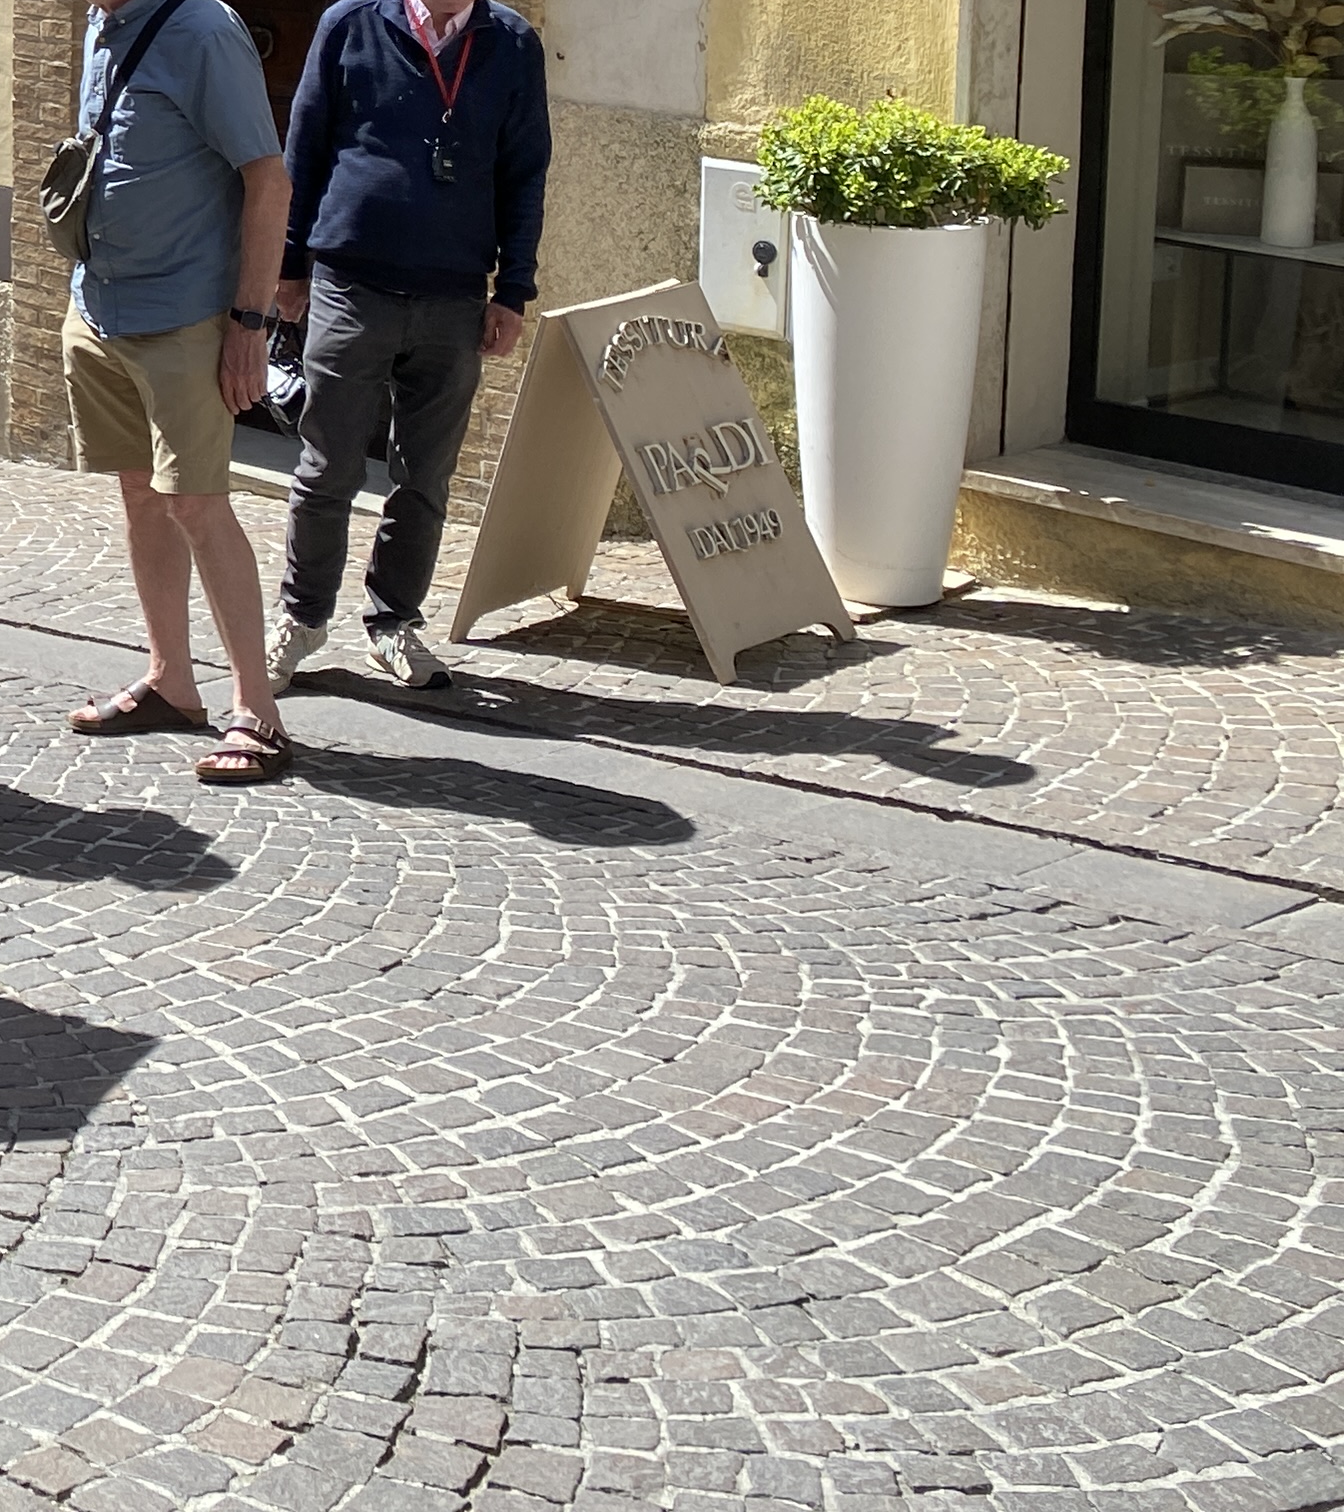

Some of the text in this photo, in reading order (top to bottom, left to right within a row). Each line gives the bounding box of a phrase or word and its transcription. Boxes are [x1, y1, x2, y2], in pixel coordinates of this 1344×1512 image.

[599, 315, 734, 392] TESSITURA
[643, 417, 774, 498] PARDI
[733, 508, 783, 547] 1949
